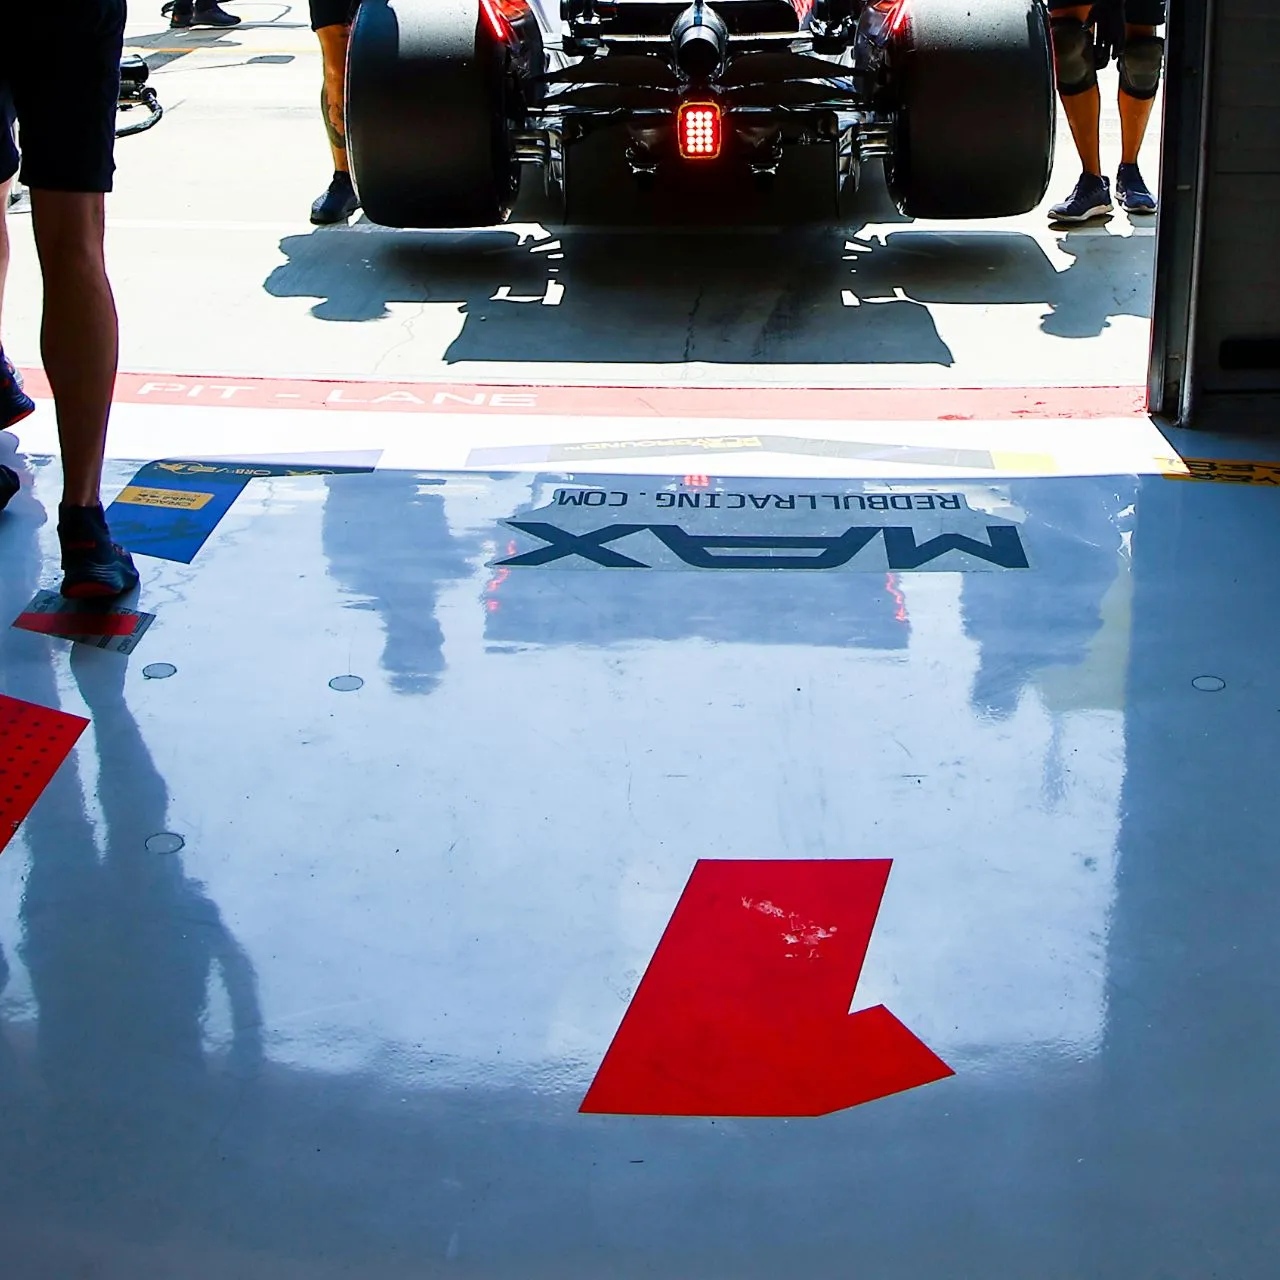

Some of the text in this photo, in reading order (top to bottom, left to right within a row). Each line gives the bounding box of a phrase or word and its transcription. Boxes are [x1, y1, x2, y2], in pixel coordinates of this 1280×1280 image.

[137, 381, 255, 400] PIT
[324, 388, 540, 407] LANE
[493, 521, 1030, 570] MAX
